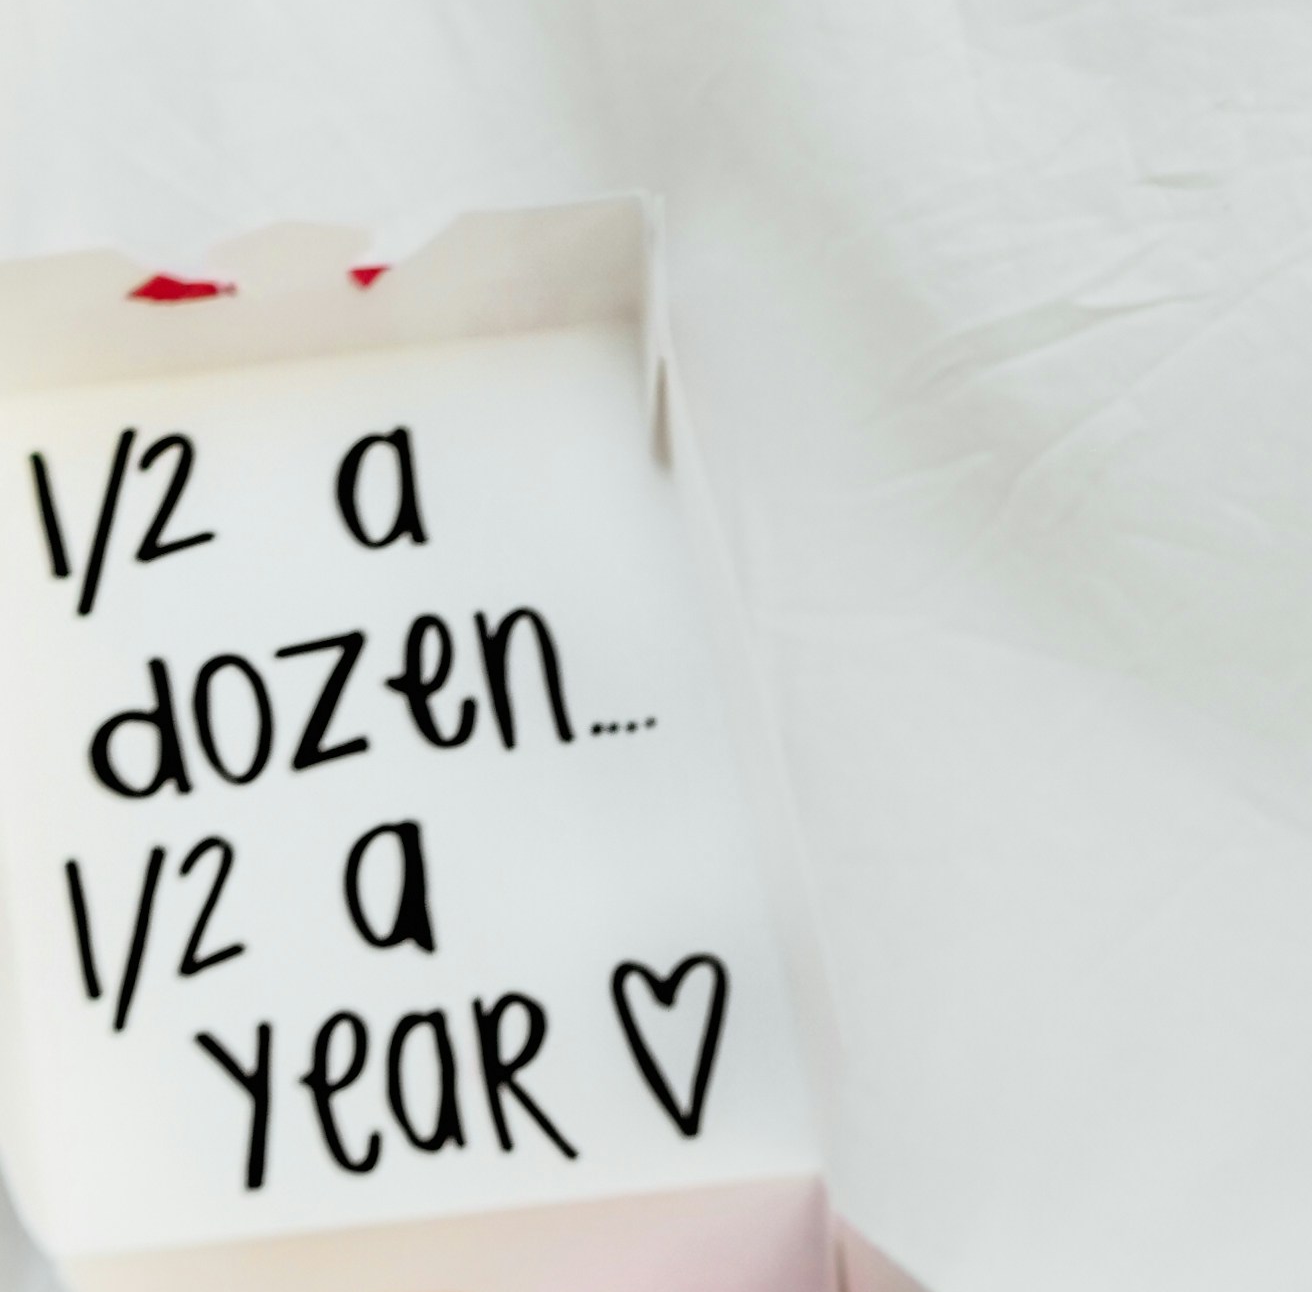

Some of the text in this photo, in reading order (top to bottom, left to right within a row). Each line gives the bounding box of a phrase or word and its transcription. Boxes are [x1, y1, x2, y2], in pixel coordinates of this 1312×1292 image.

[29, 425, 429, 617] 1/2 a
[64, 819, 437, 1033] 1/2 a
